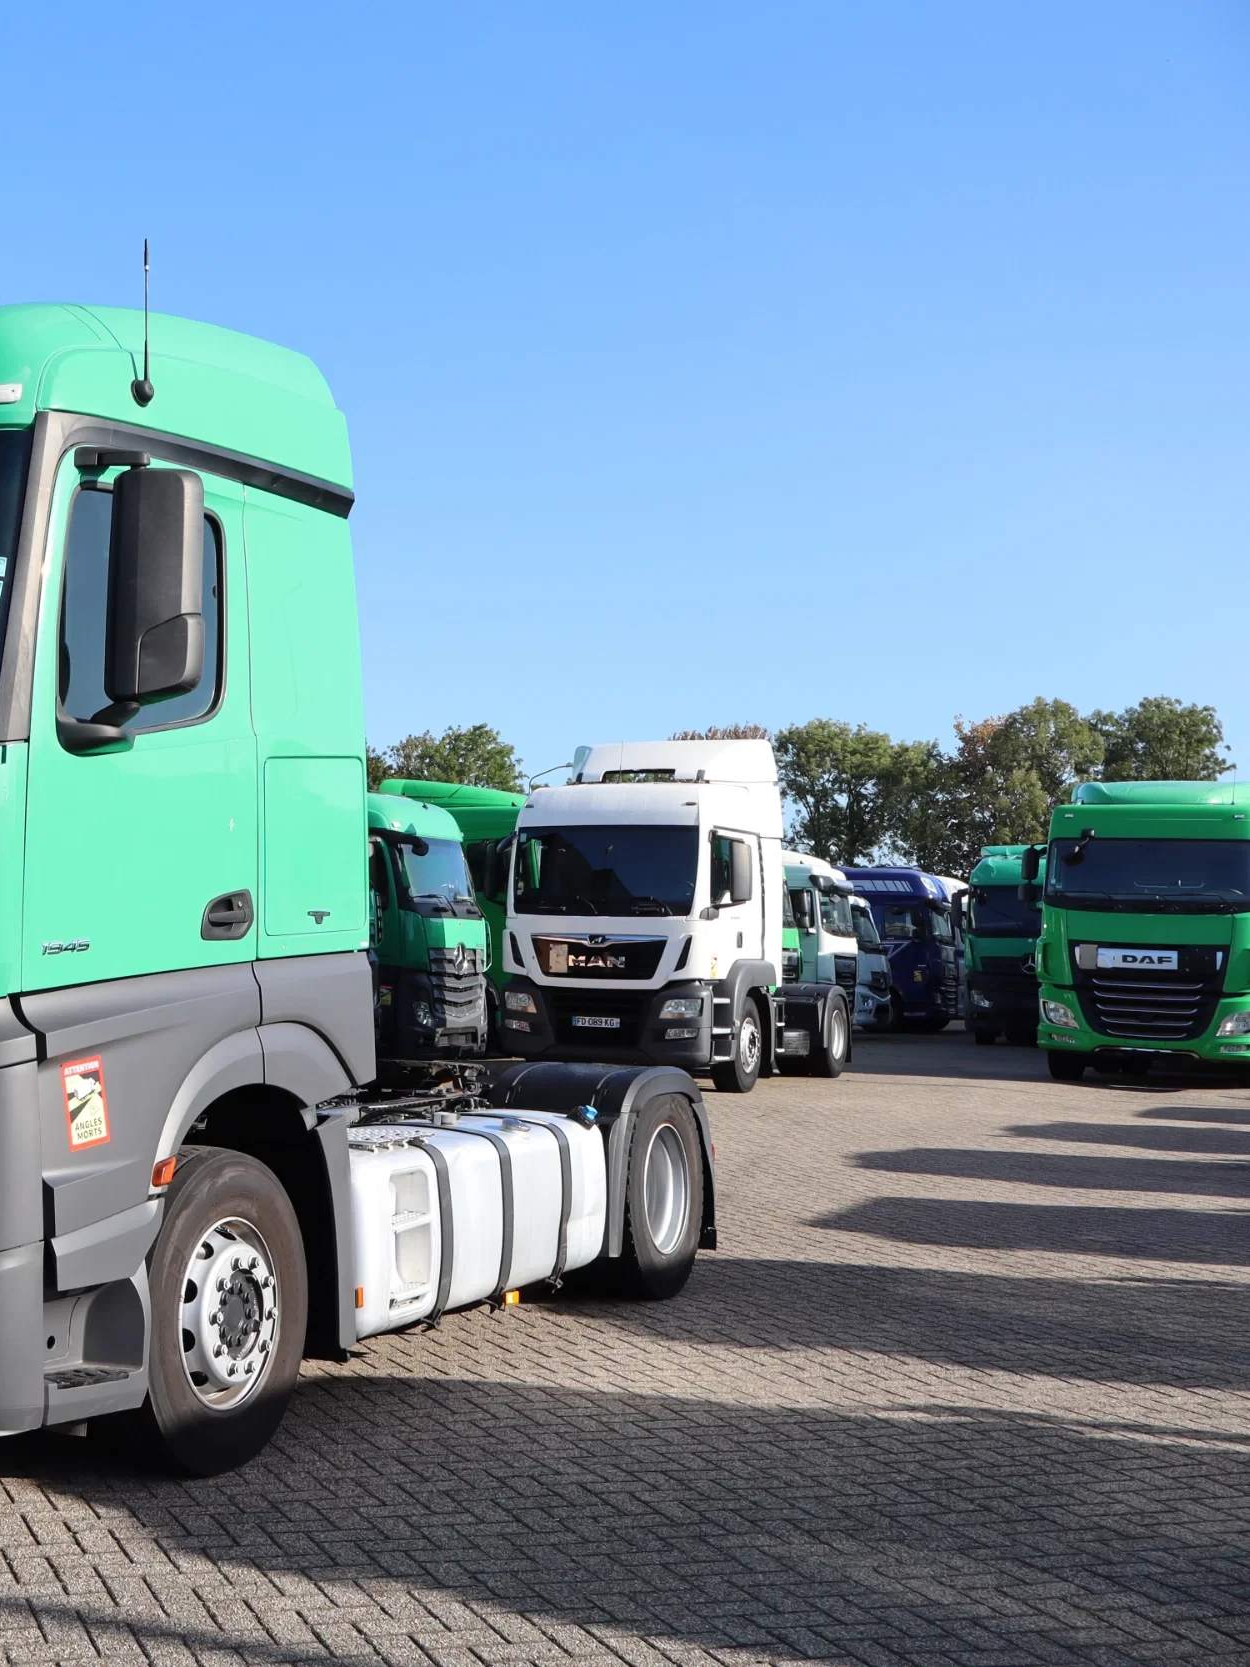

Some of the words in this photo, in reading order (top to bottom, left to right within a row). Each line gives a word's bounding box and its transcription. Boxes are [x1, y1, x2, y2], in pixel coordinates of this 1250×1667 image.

[42, 939, 90, 956] 1945
[568, 954, 626, 968] MAN
[1121, 954, 1173, 965] DAF
[63, 1060, 99, 1076] ATTENTION
[75, 1117, 103, 1131] ANGLES
[77, 1127, 103, 1141] MORTS
